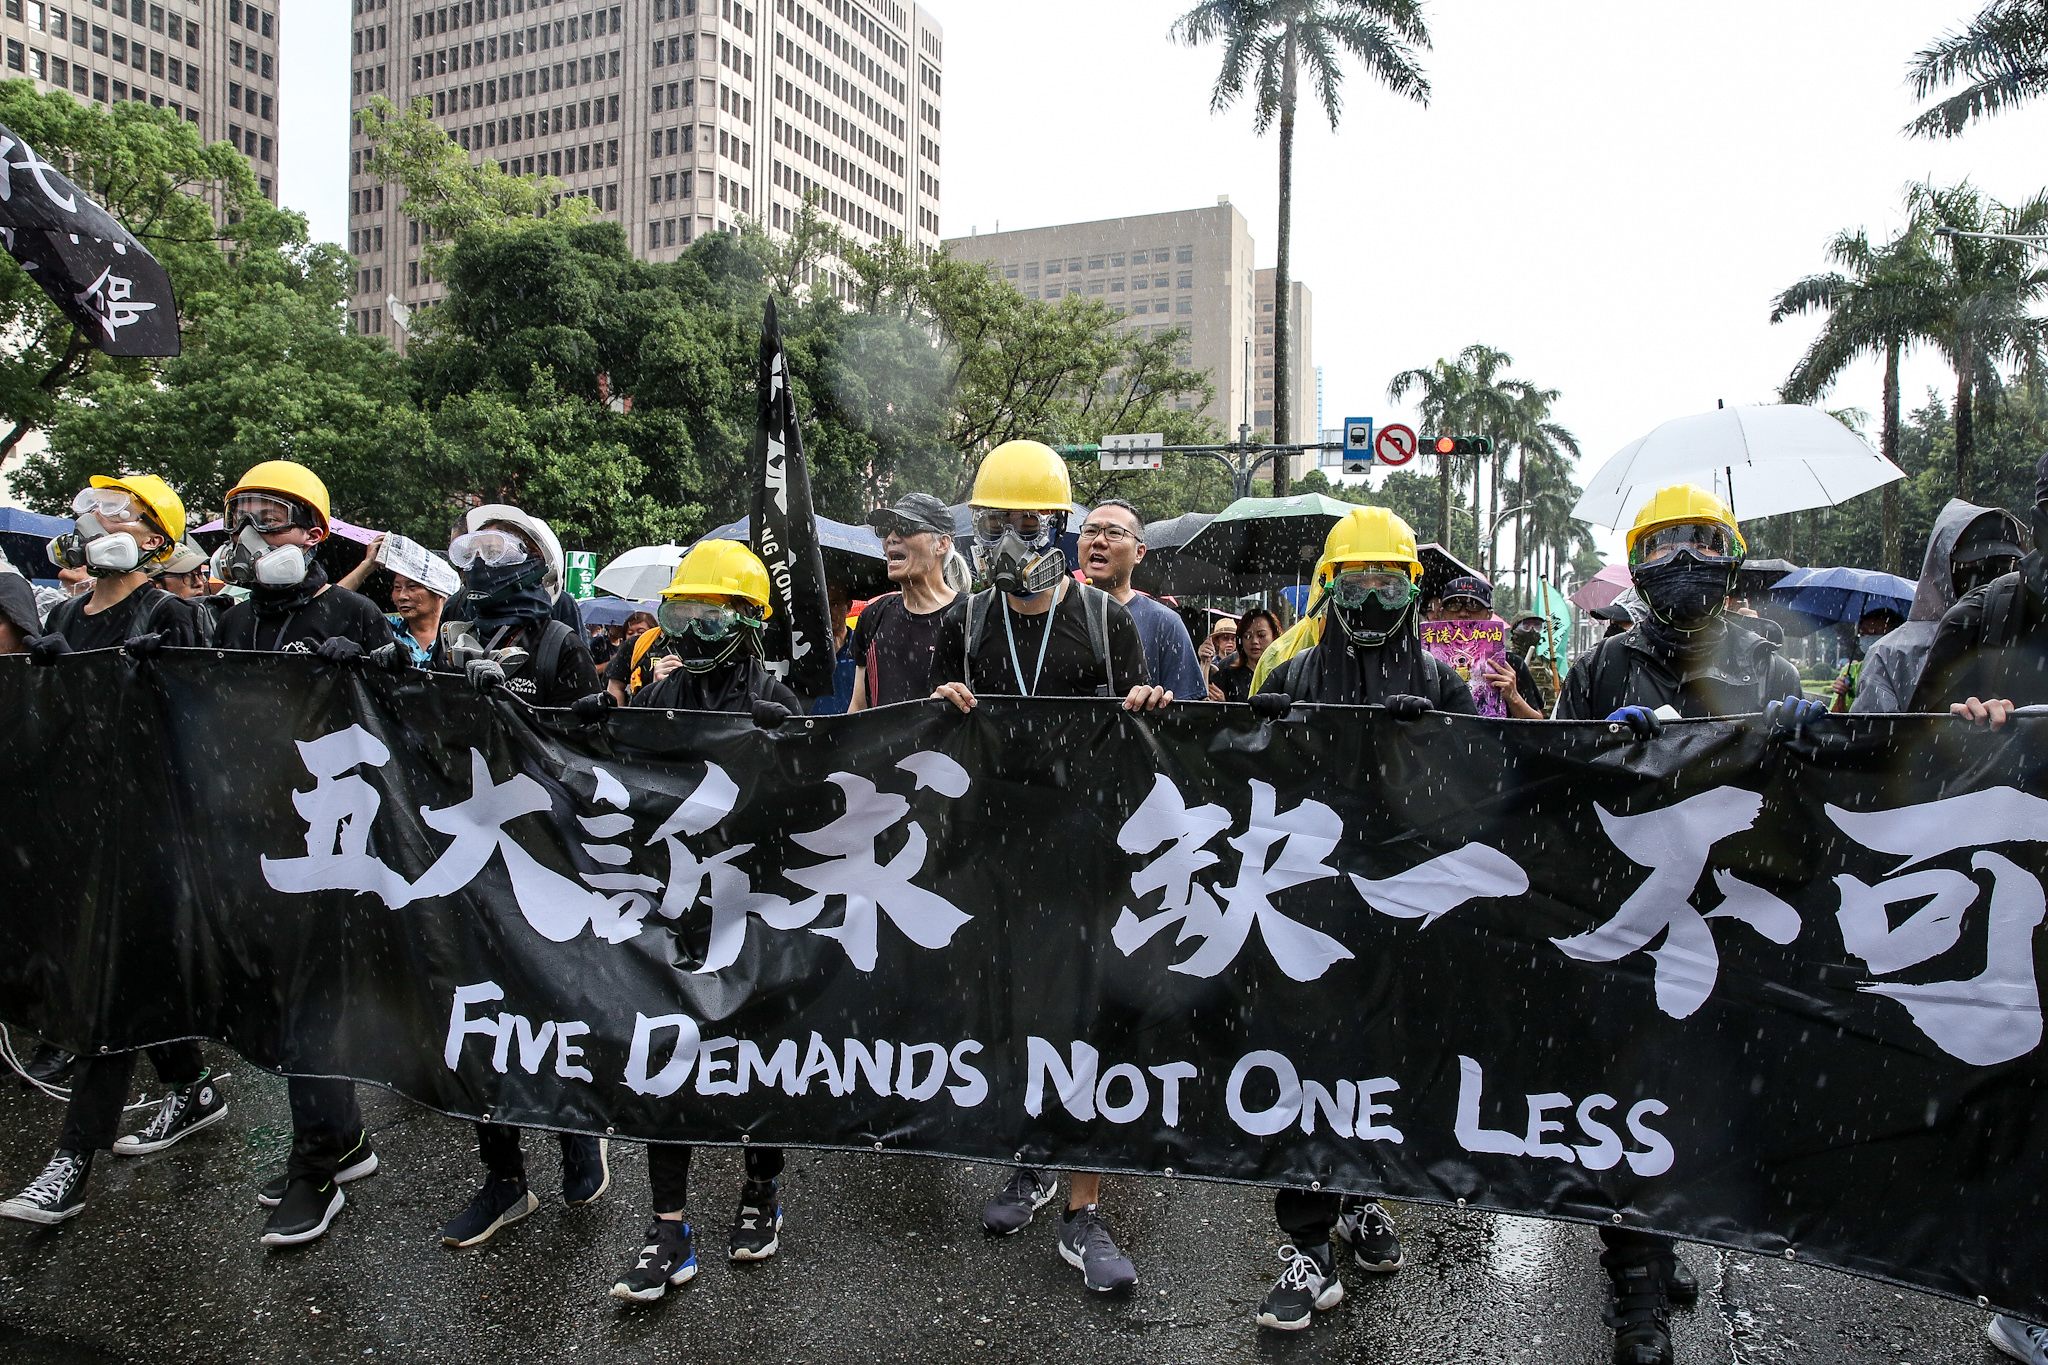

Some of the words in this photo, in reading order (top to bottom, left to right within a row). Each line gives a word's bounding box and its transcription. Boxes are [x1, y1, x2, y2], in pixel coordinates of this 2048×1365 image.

[769, 560, 793, 613] KON
[1422, 626, 1502, 643] 香港人加油
[261, 724, 974, 974] 五大訴求
[1111, 773, 2048, 1067] 缺一不可
[444, 981, 593, 1082] FIVE
[624, 1012, 988, 1107] DEMANDS
[1024, 1036, 1197, 1128] NOT
[1226, 1049, 1403, 1144] ONE
[1454, 1054, 1675, 1176] LESS
